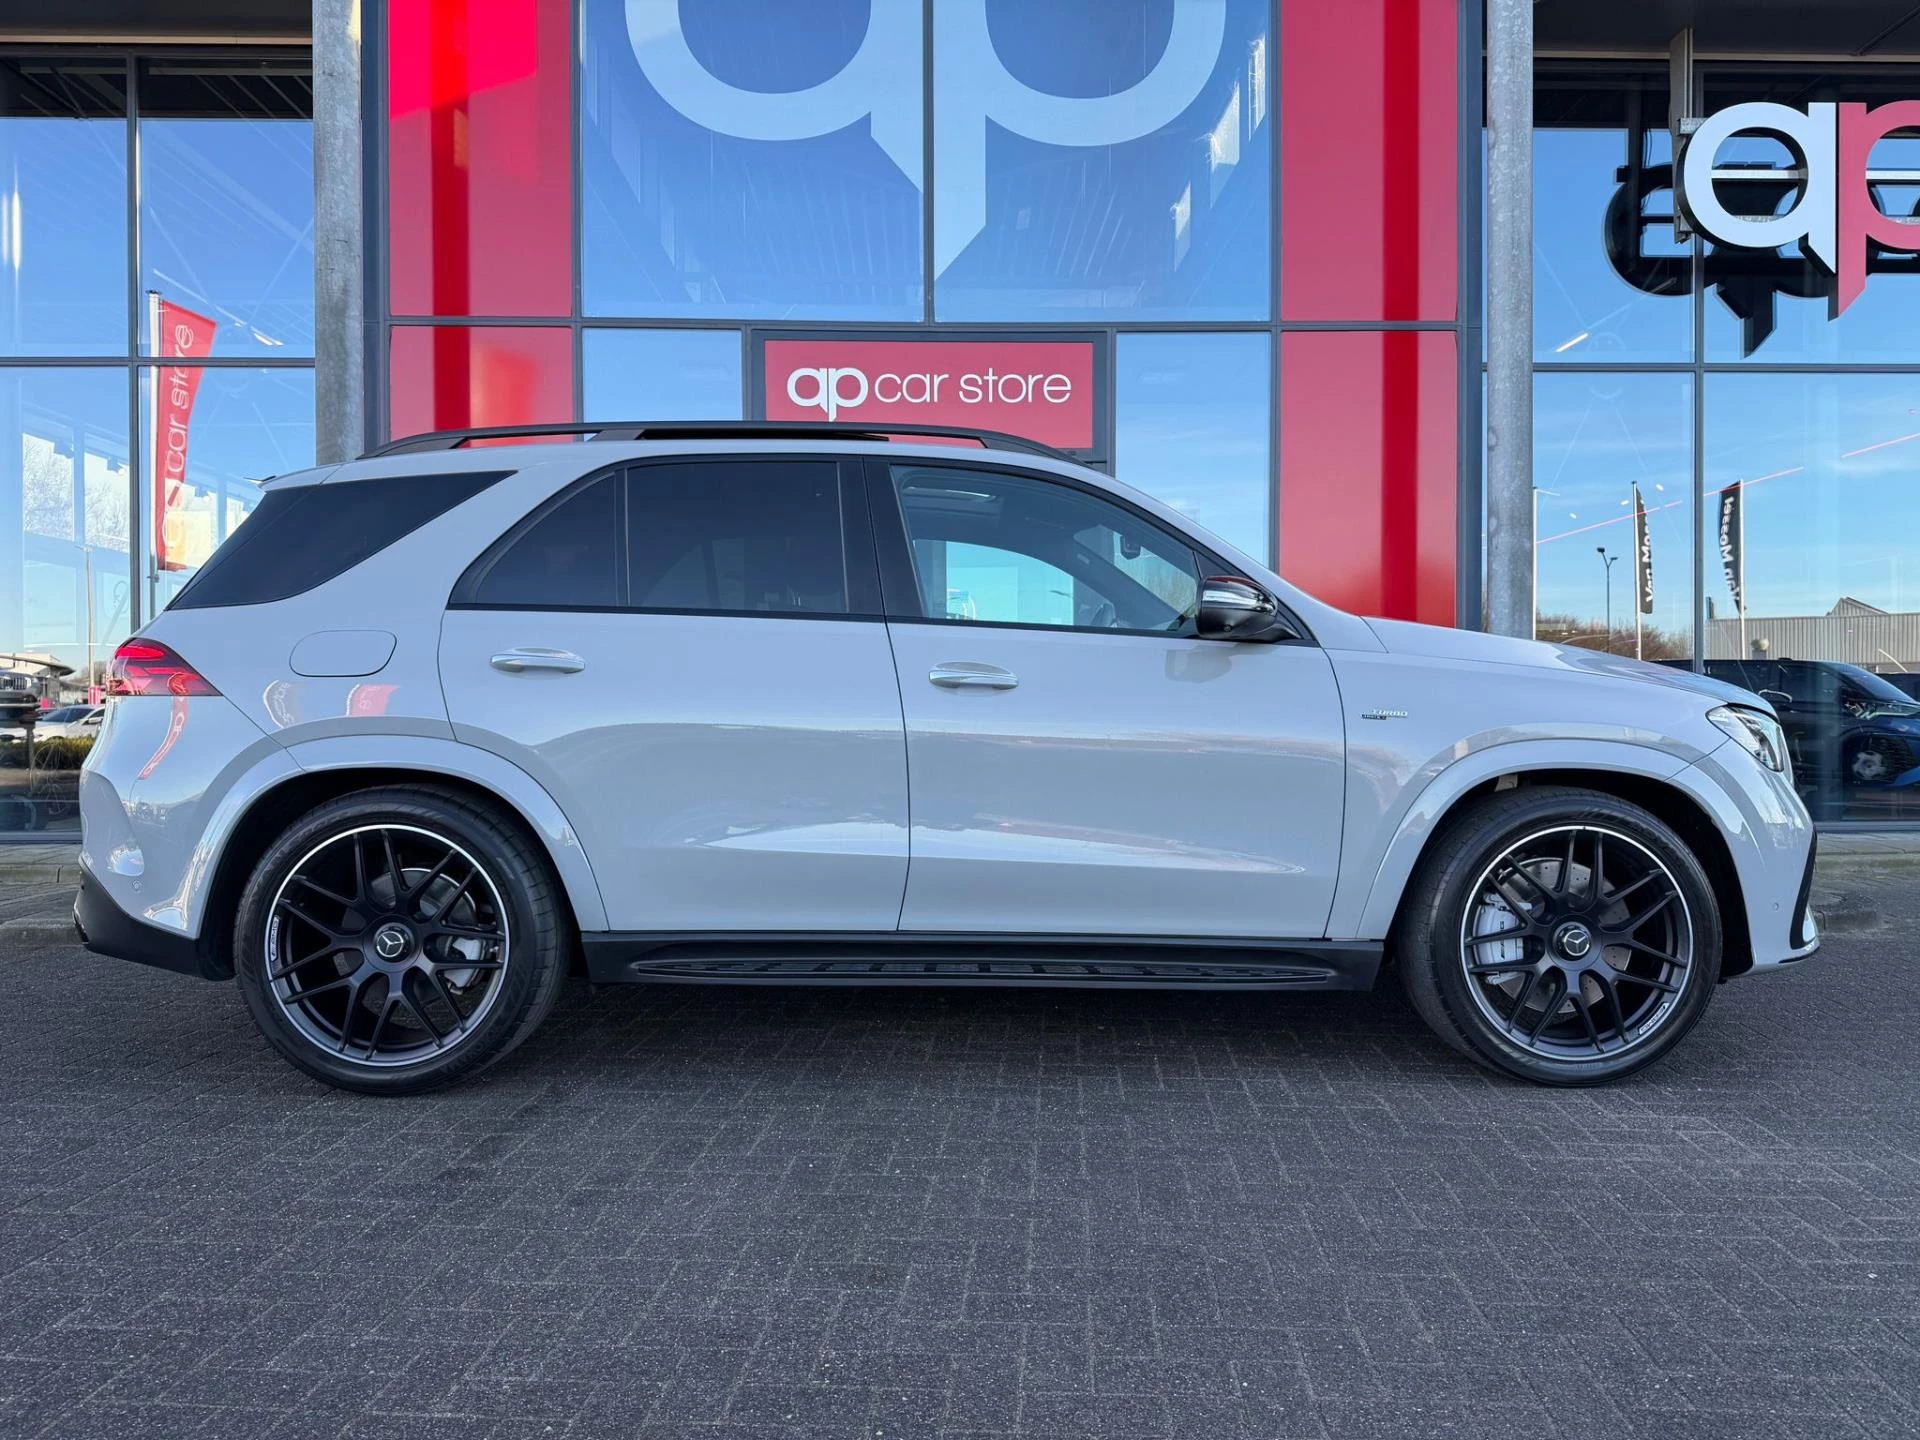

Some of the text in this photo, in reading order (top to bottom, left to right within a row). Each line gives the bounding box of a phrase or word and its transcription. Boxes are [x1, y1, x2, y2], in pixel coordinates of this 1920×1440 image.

[786, 366, 1072, 422] ap car store
[167, 415, 189, 473] car
